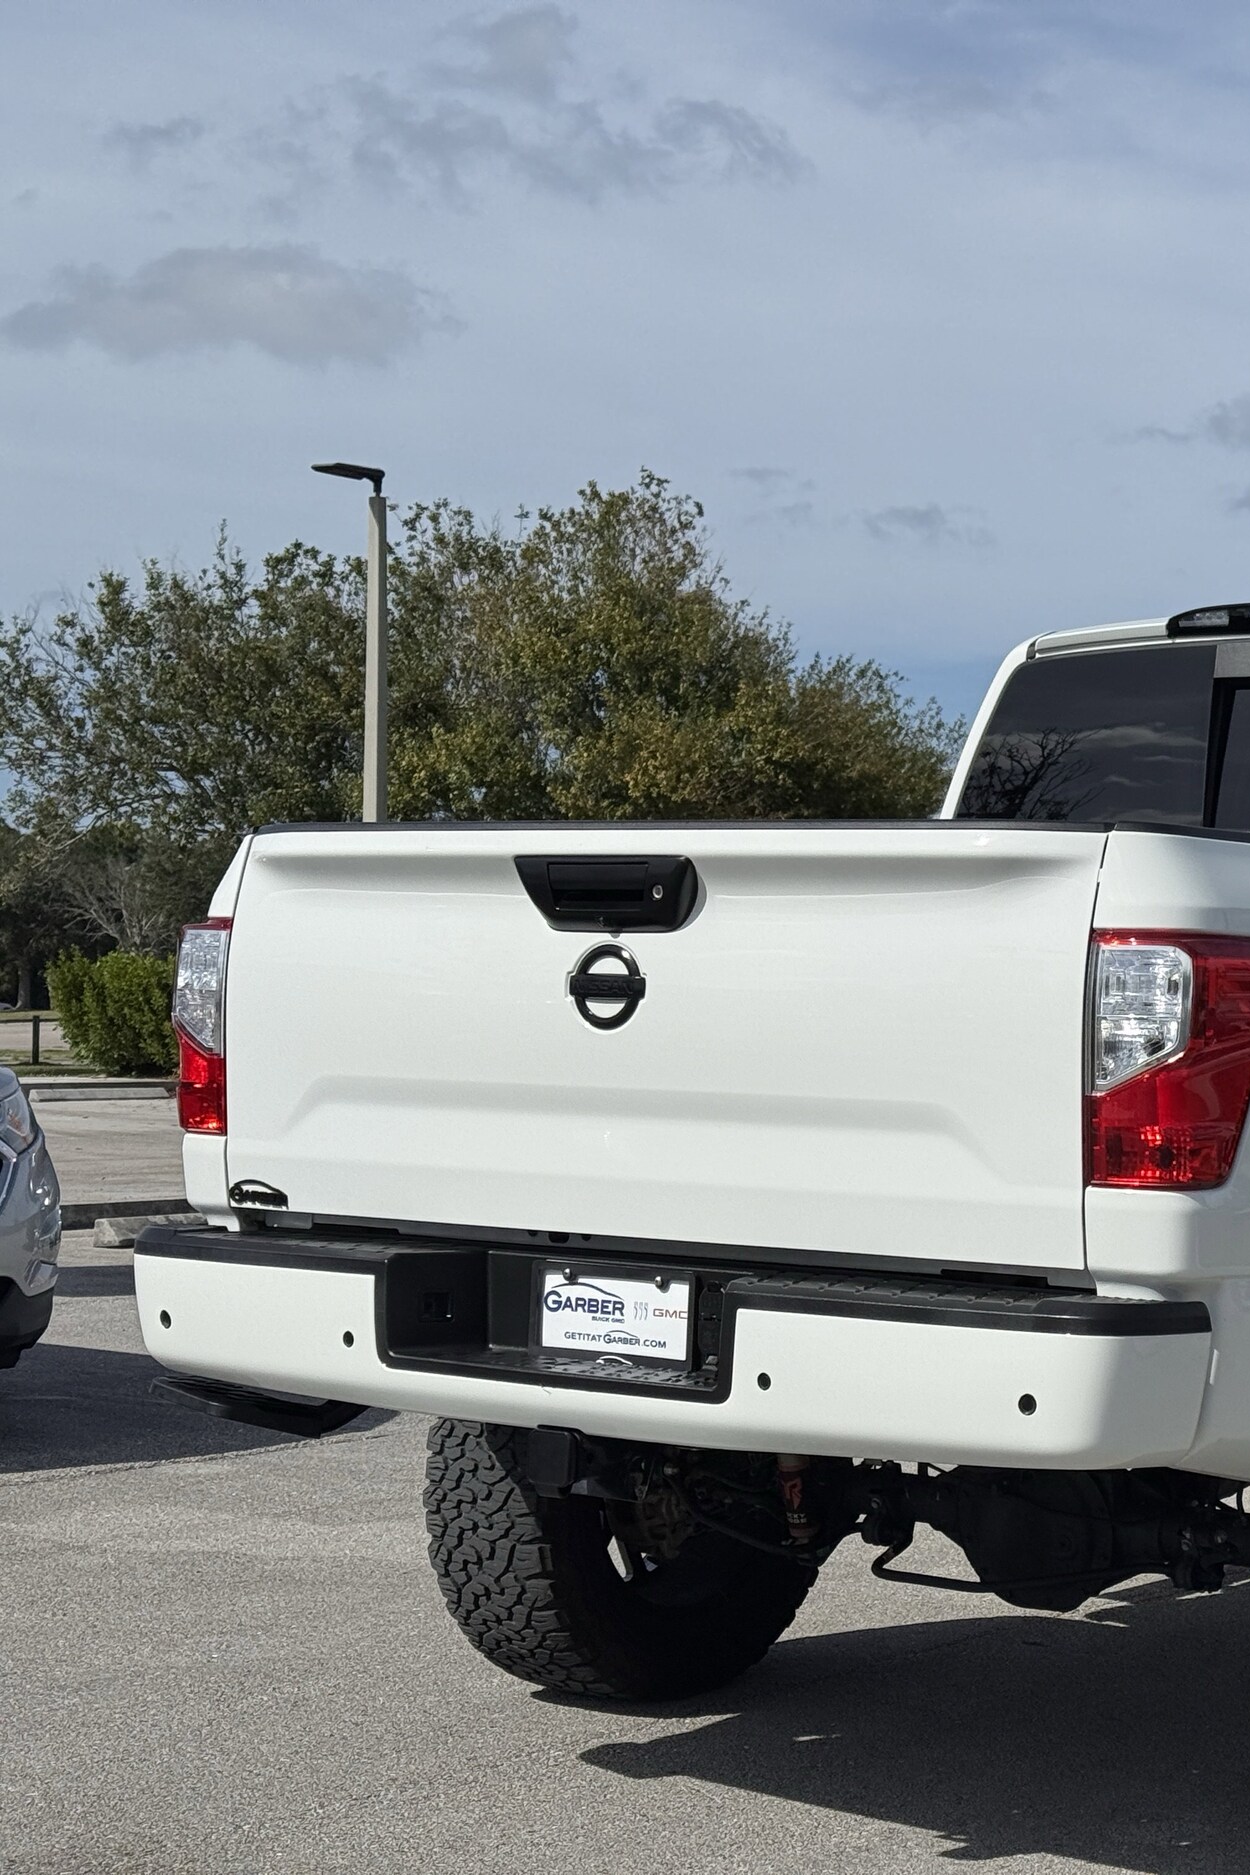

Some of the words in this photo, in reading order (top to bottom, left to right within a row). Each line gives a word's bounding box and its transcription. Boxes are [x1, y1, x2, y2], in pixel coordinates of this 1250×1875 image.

[574, 977, 634, 995] NISSAN
[543, 1290, 625, 1317] GARBER
[653, 1308, 688, 1320] GMC
